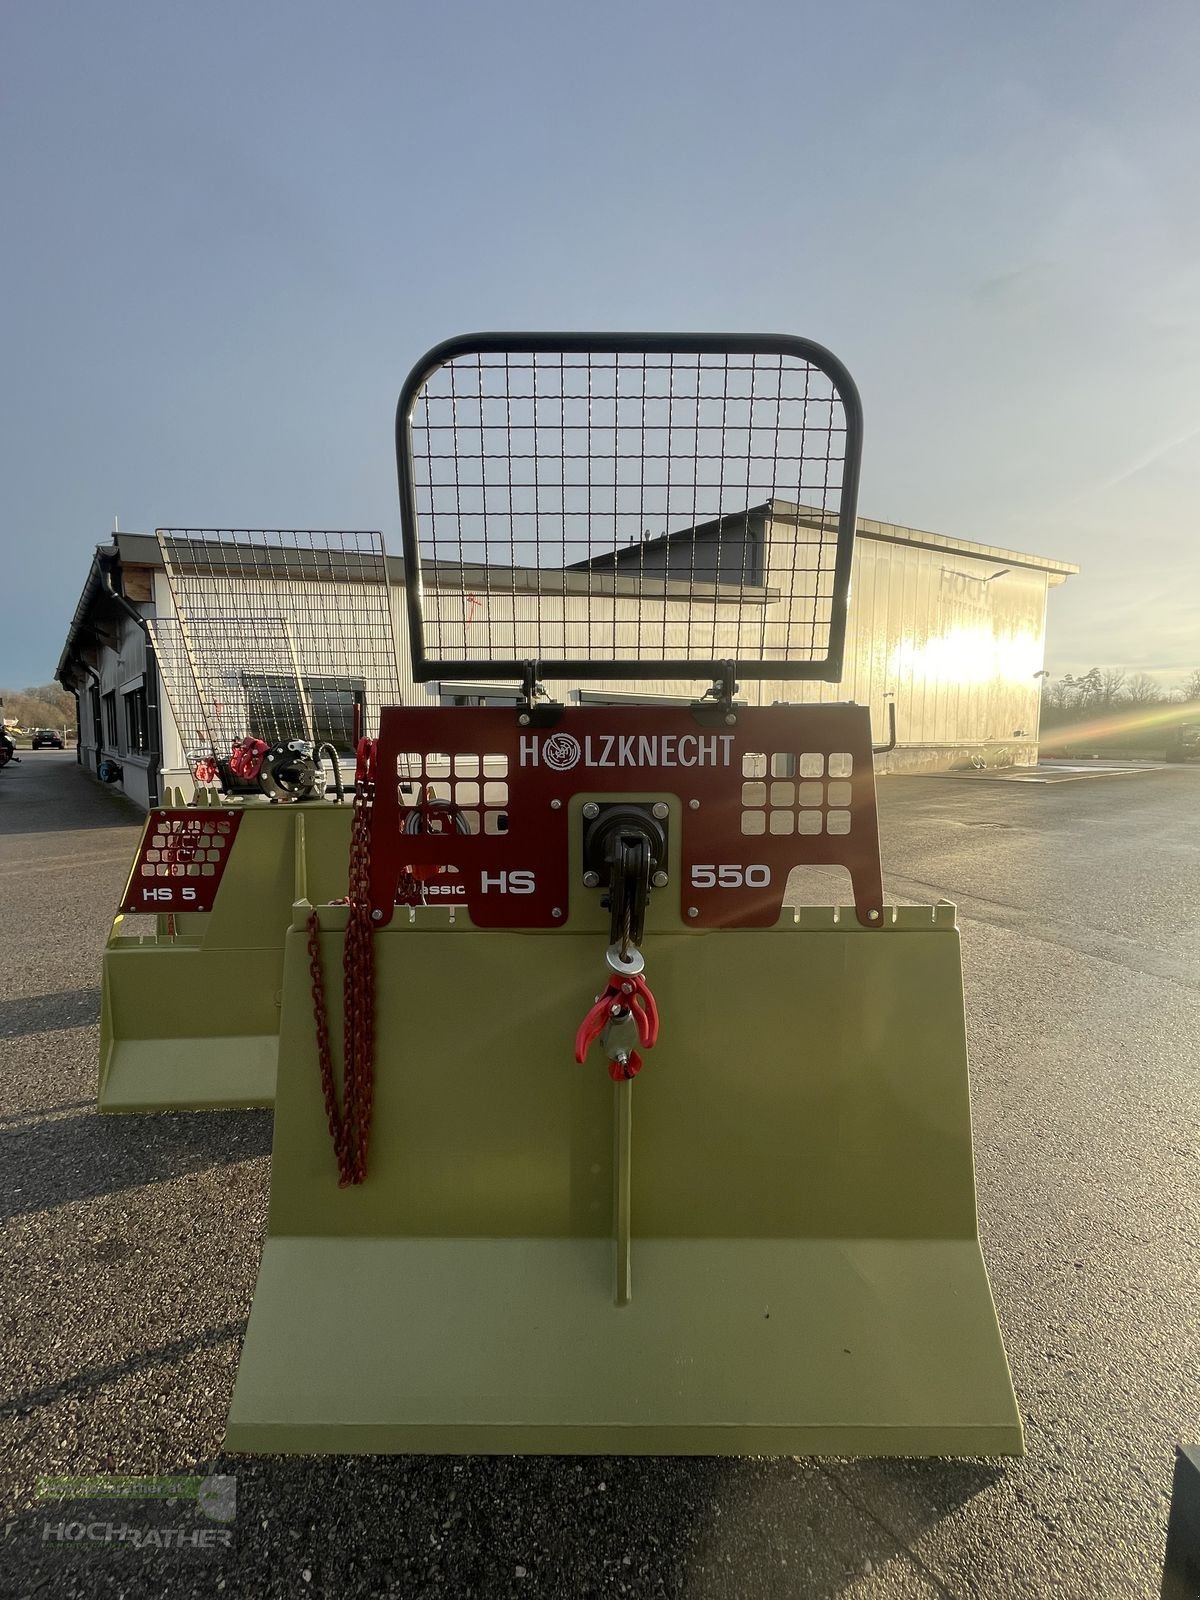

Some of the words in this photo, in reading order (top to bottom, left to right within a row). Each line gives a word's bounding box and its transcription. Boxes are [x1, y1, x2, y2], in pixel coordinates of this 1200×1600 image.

[519, 732, 735, 770] HOLZKNECHT
[420, 885, 466, 895] assic
[481, 870, 535, 894] HS
[691, 864, 771, 888] 550
[143, 888, 173, 901] HS
[182, 887, 197, 900] 5
